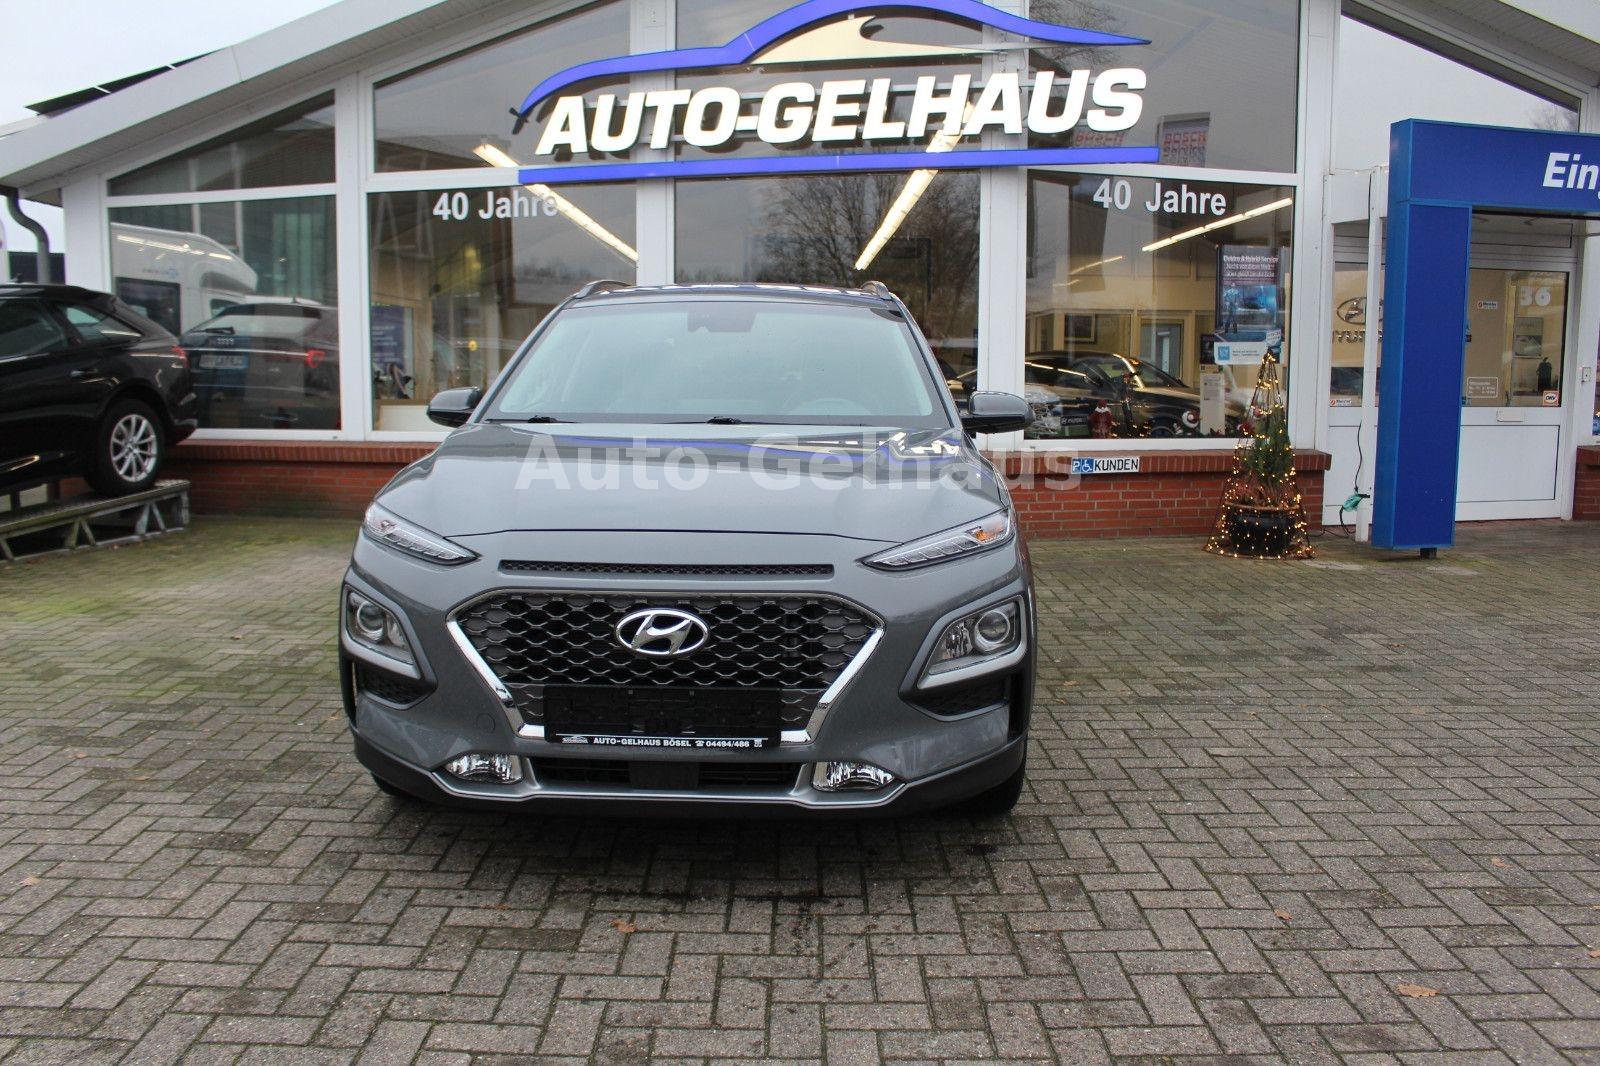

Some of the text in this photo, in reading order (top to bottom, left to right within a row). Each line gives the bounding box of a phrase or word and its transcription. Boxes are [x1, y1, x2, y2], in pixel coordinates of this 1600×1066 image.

[534, 68, 1148, 156] AUTO-GELHAUS
[1542, 152, 1600, 199] Ein
[432, 190, 558, 220] 40 Jahre
[1093, 178, 1227, 216] 40 Jahre
[1519, 285, 1551, 307] 36
[1094, 458, 1139, 472] KUNDEN
[593, 738, 661, 747] AUTO-GELHAUS
[663, 738, 692, 747] BÖSEL
